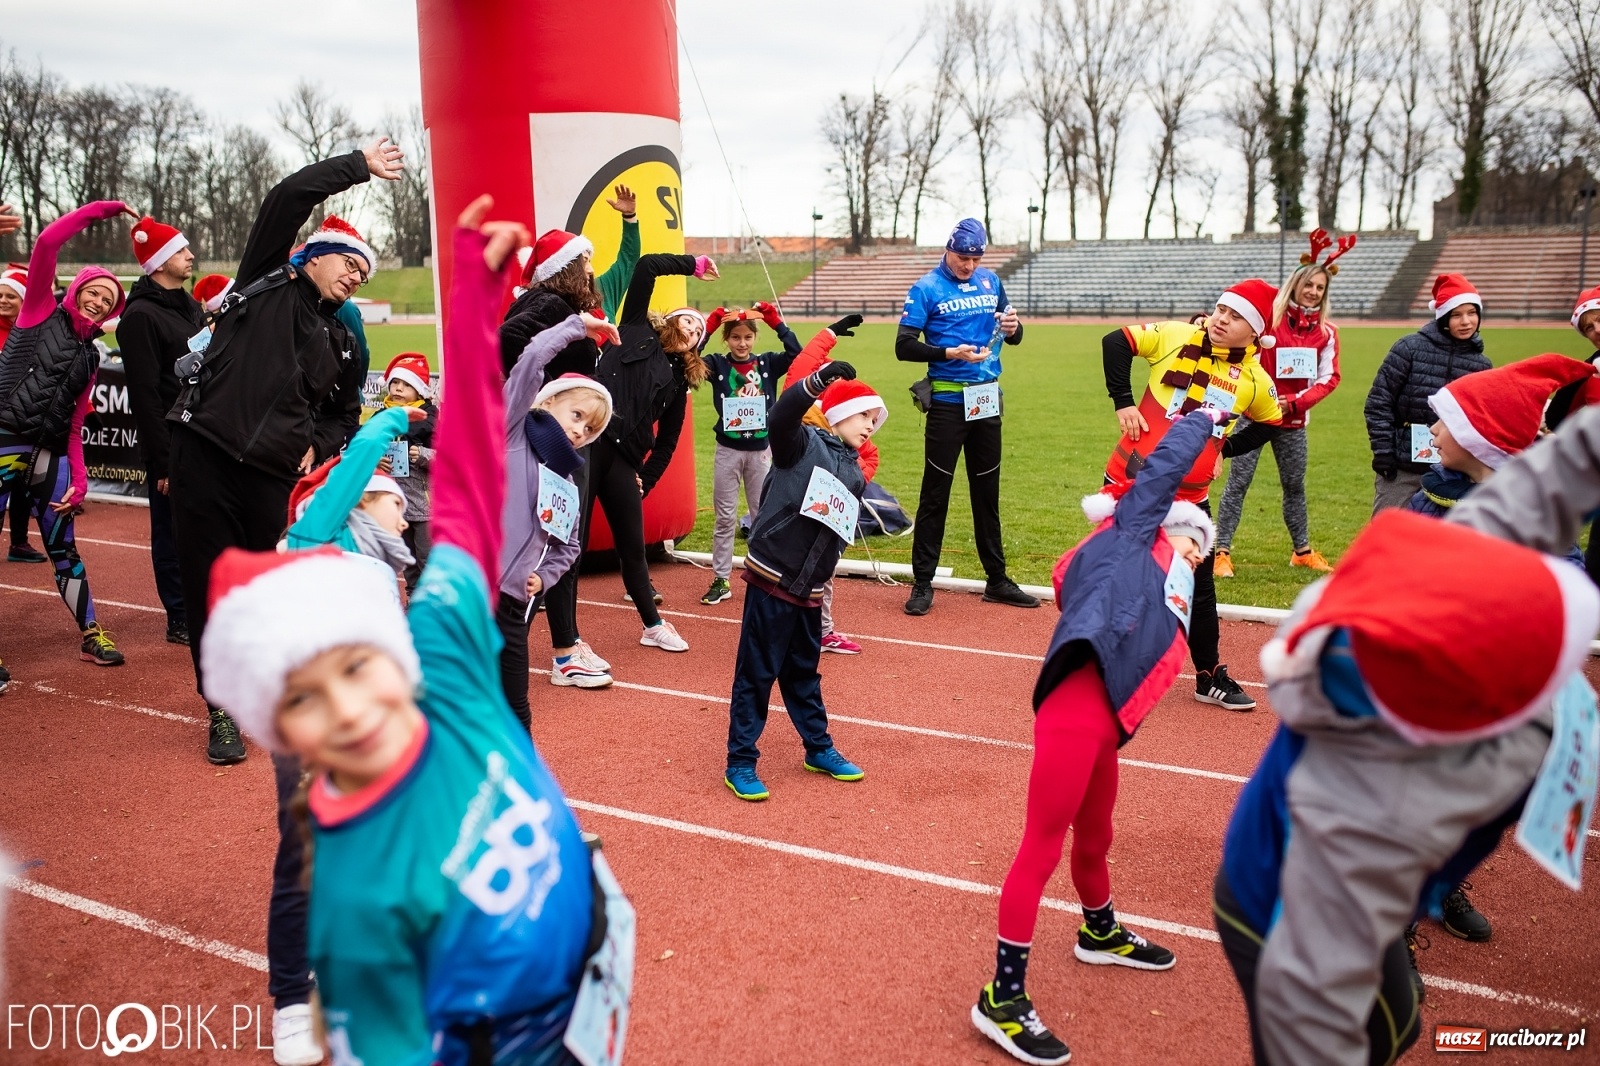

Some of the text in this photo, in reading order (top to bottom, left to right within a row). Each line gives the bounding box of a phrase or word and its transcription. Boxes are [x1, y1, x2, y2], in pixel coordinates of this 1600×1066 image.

[1292, 358, 1305, 366] 171
[977, 395, 990, 405] 058
[737, 408, 755, 417] 006
[551, 493, 567, 513] 005
[829, 494, 845, 514] 100
